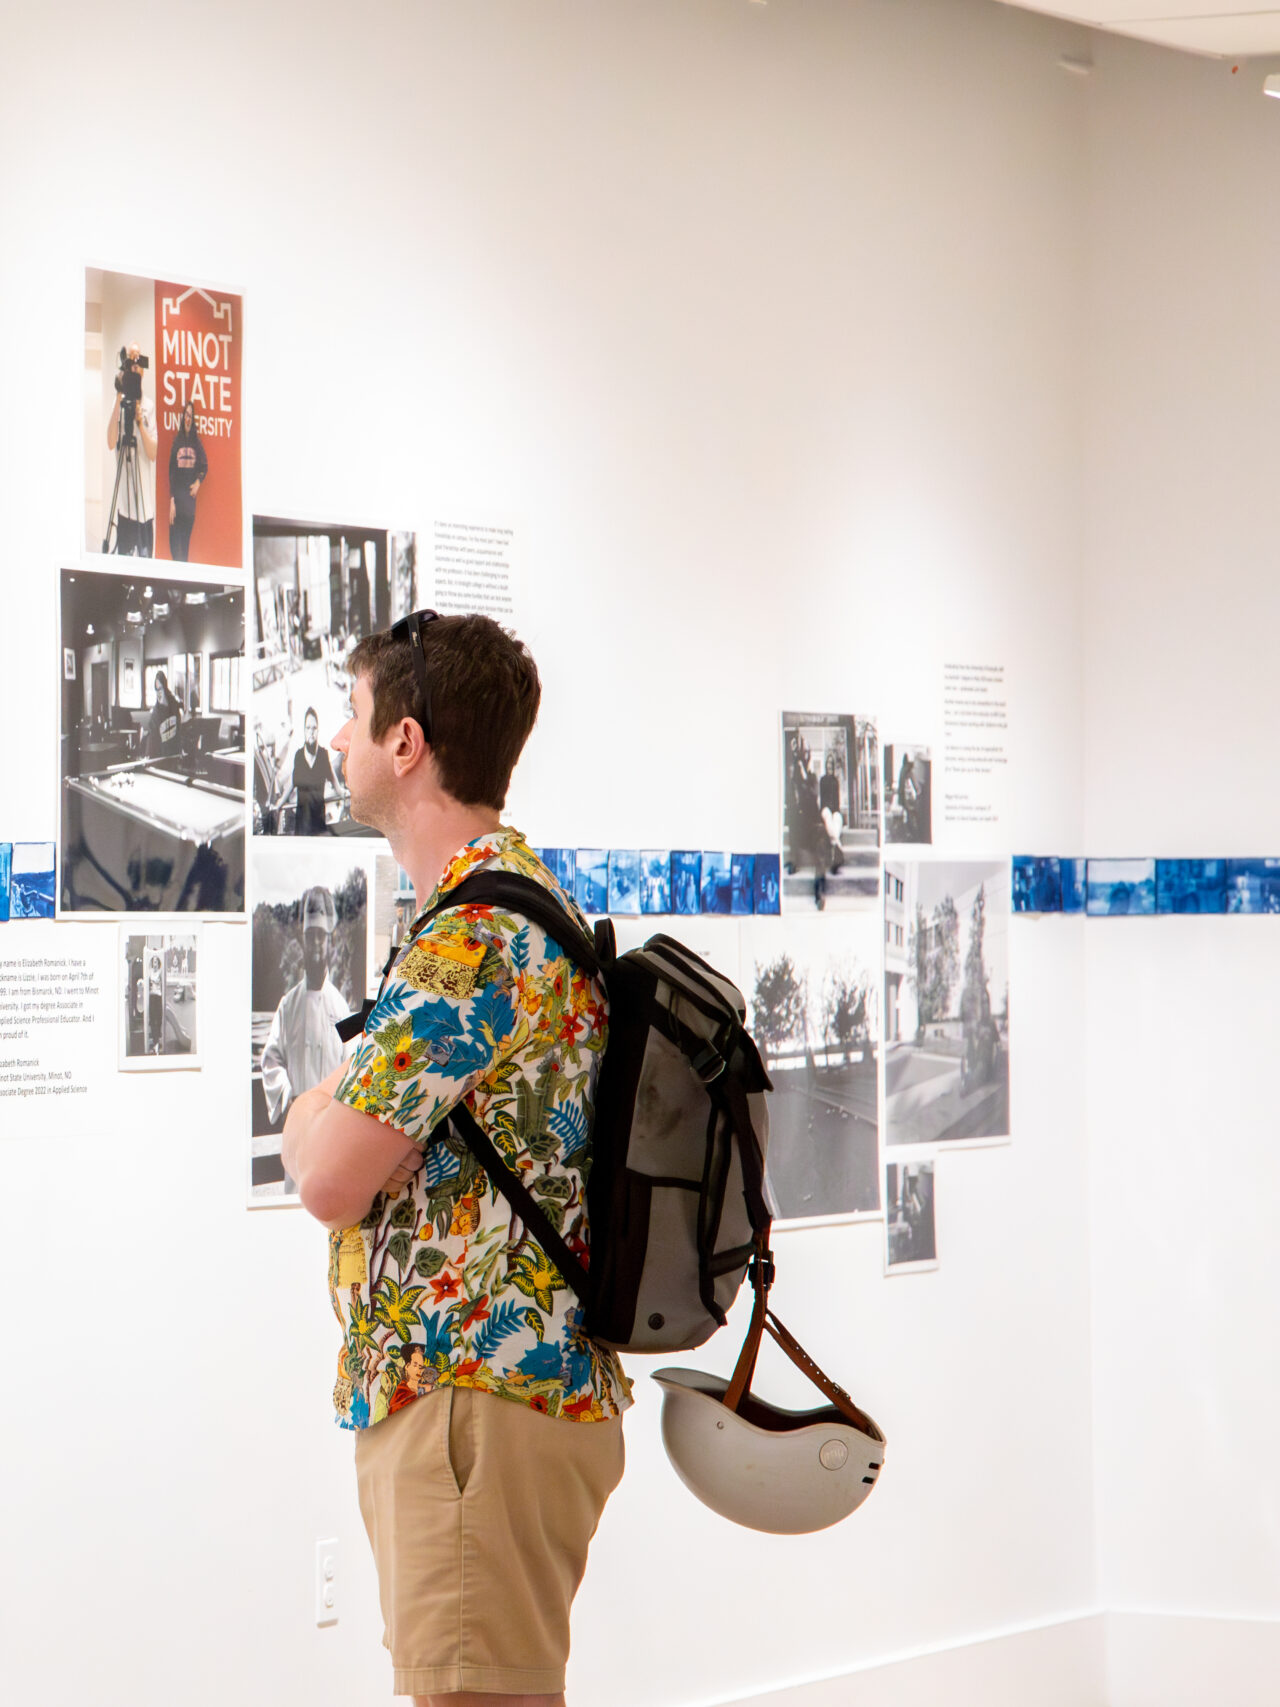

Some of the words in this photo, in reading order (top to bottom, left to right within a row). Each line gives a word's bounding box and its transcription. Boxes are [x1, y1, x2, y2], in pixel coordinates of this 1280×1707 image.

[162, 328, 232, 370] MINOT
[163, 370, 232, 412] STATE
[164, 411, 232, 438] UNERSITY
